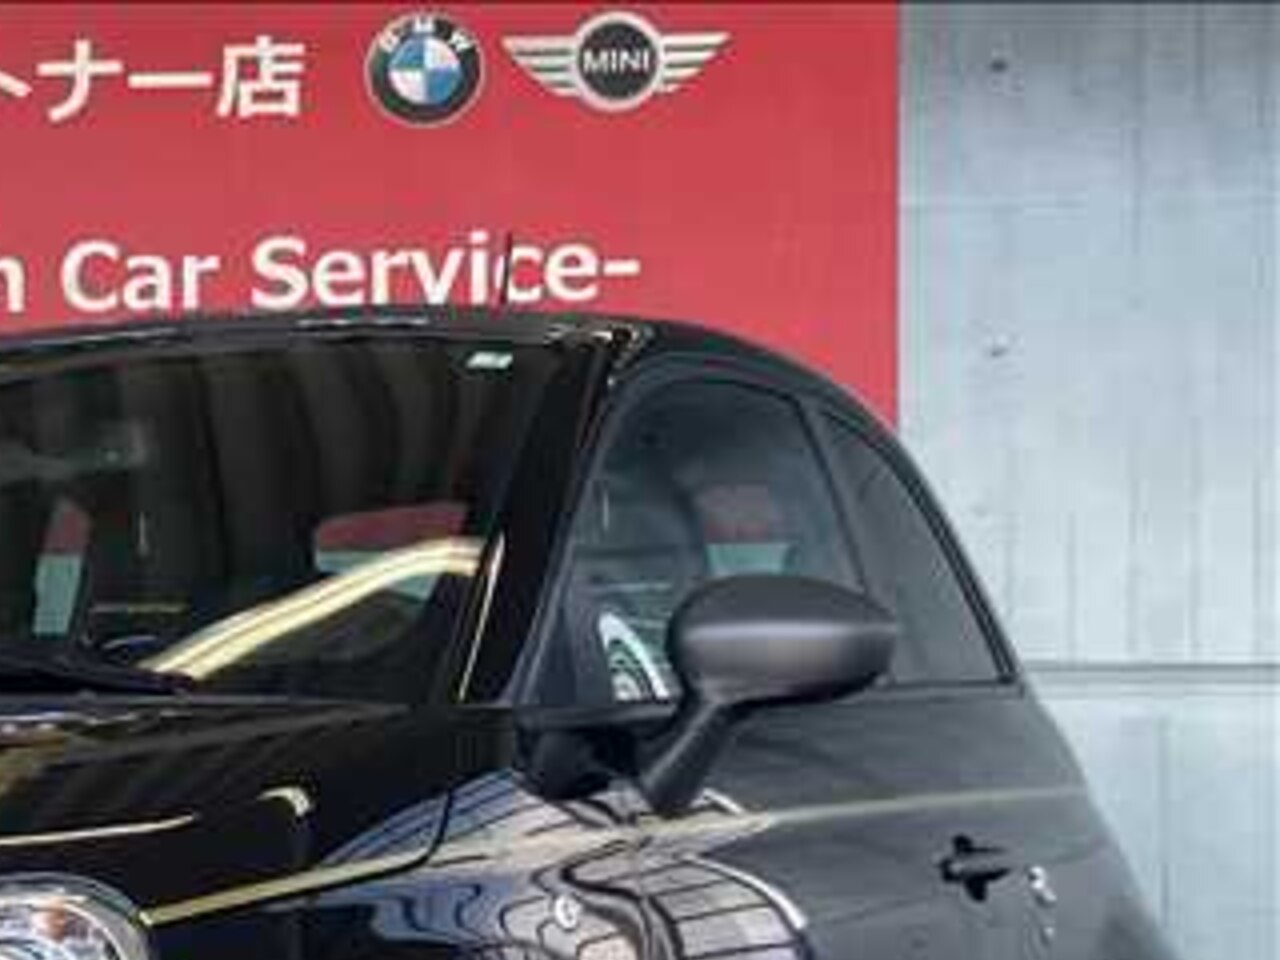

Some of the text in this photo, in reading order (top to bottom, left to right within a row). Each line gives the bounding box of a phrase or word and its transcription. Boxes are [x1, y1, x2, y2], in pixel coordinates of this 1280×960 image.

[581, 49, 651, 74] MINI
[60, 244, 220, 313] Car
[250, 231, 641, 308] Service-
